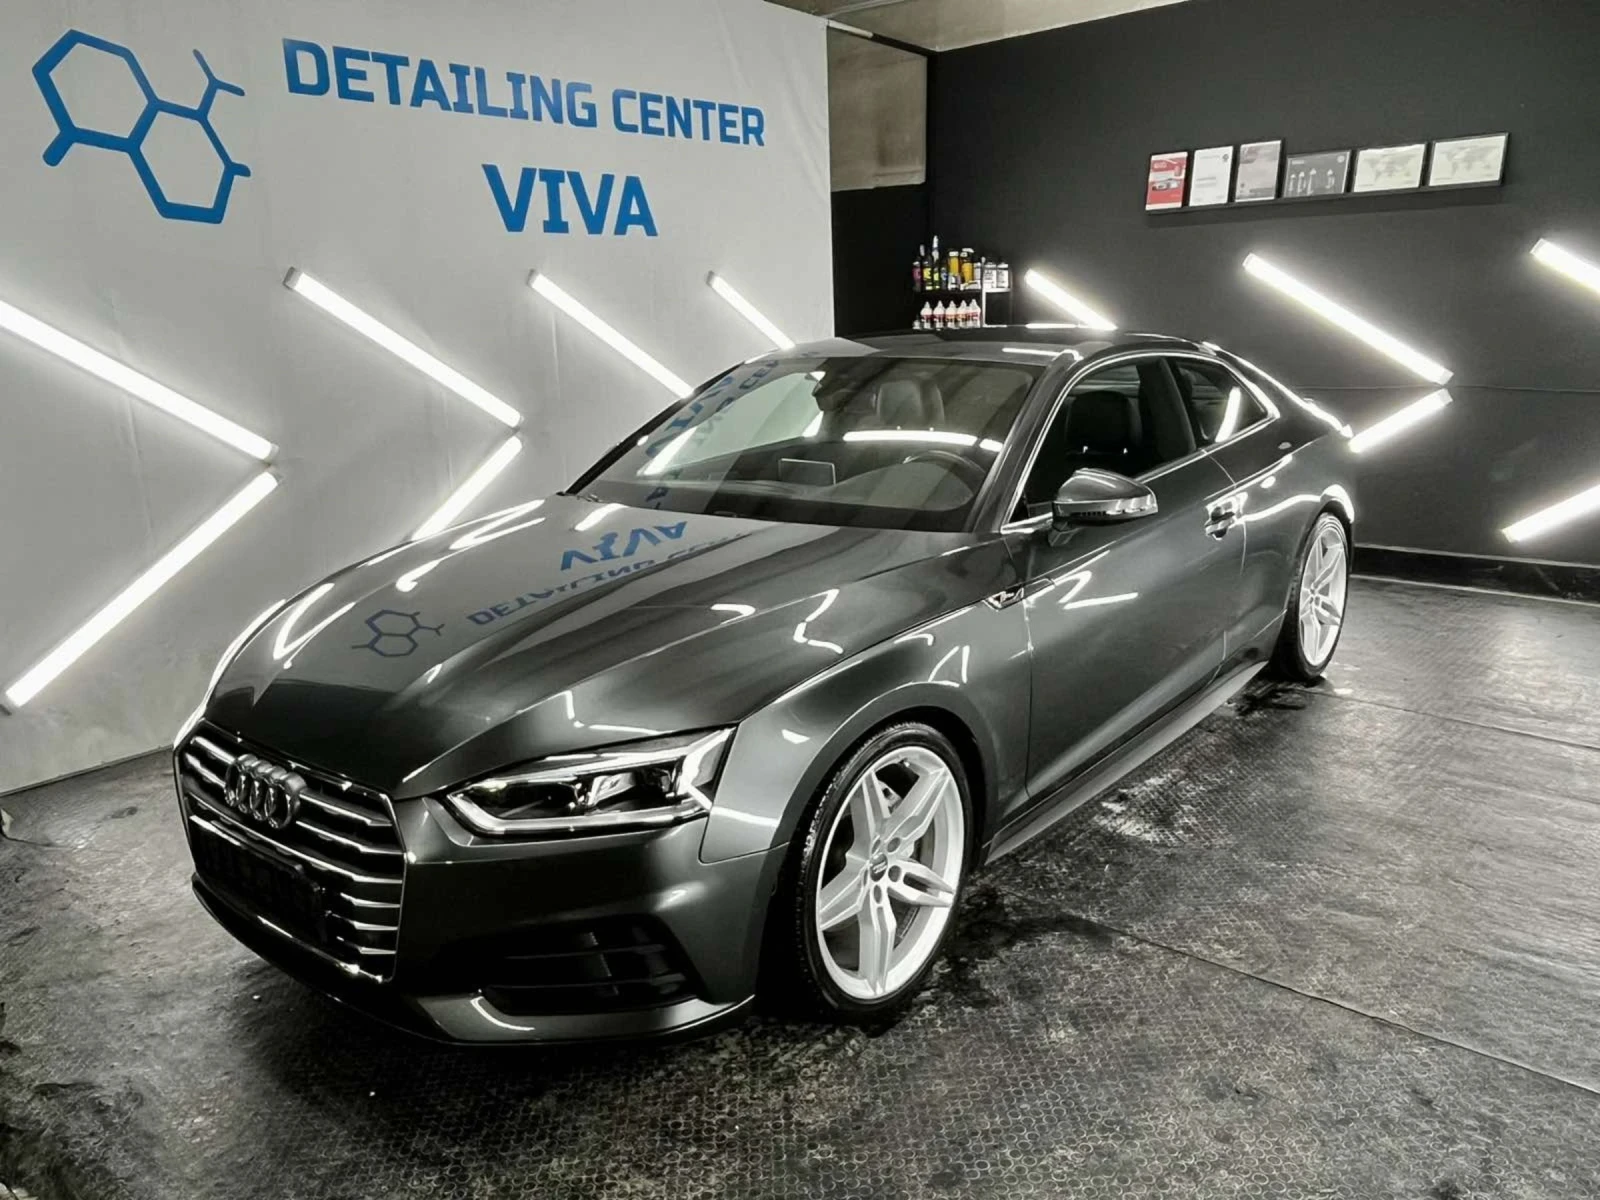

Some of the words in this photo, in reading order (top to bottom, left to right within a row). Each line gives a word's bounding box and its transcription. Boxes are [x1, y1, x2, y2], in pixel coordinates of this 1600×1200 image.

[282, 38, 598, 128] DETAILING
[613, 89, 765, 147] CENTER
[482, 164, 658, 236] VIVA
